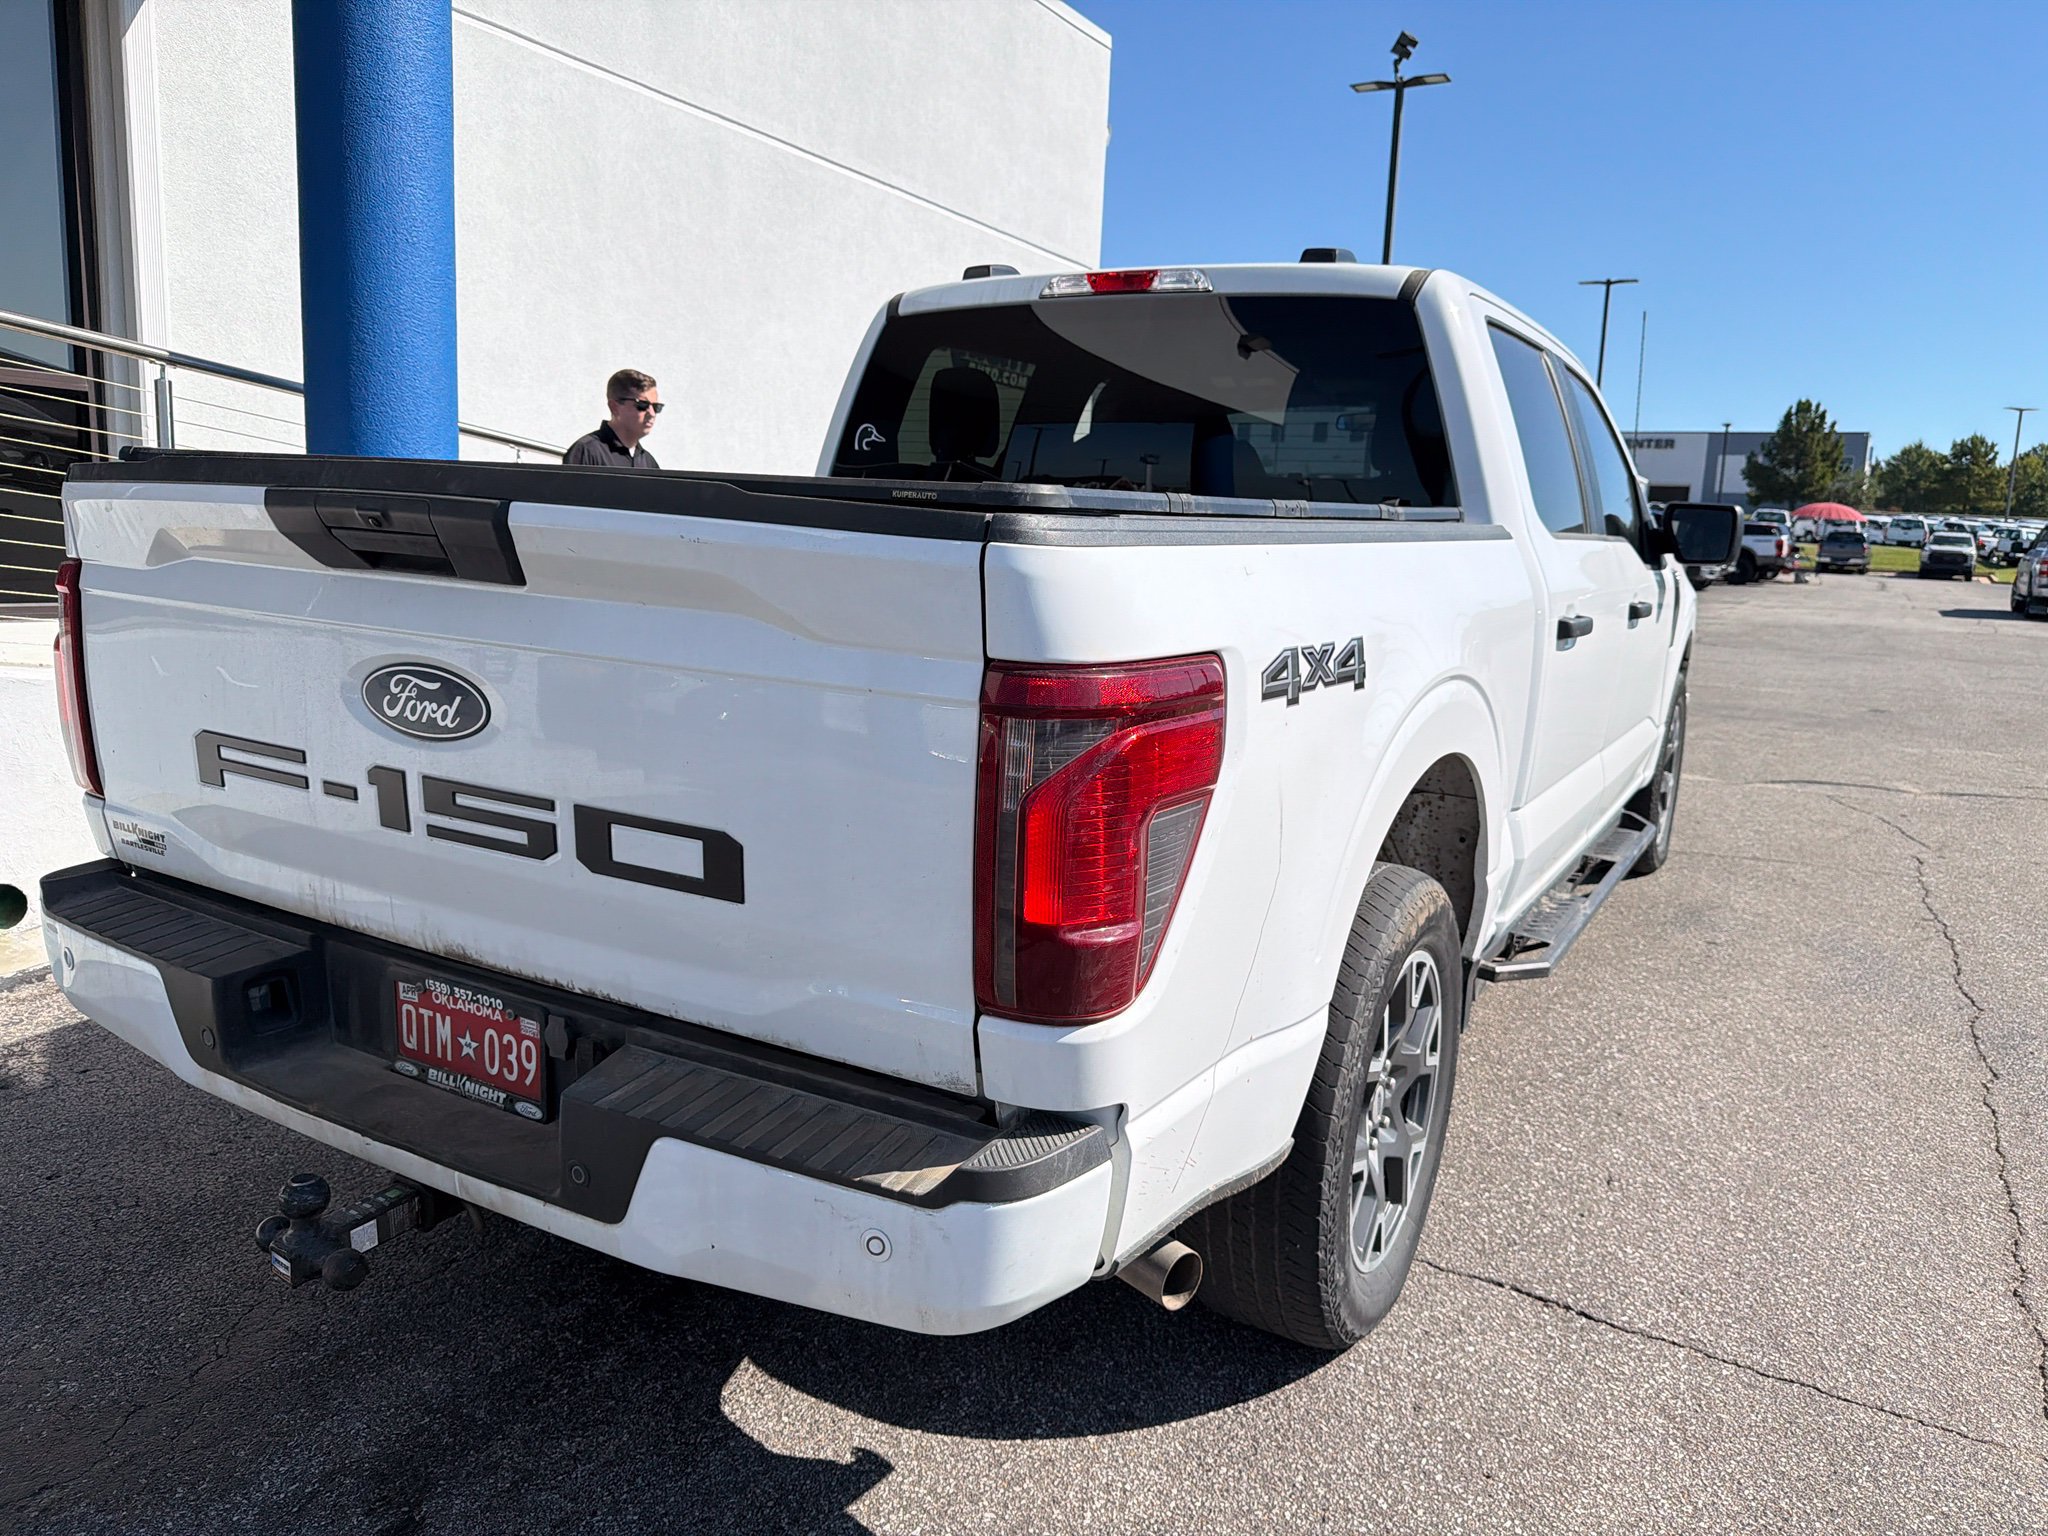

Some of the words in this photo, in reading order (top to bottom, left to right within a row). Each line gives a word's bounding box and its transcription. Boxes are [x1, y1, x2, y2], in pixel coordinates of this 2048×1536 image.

[892, 490, 937, 500] KUIPERAUTO
[382, 673, 462, 728] Ford
[194, 729, 746, 905] F-150
[120, 837, 166, 857] BARTLESVILLE
[425, 978, 451, 996] (539)
[453, 986, 504, 1011] 357-1010
[431, 991, 503, 1022] OKLAHOMA
[401, 1003, 453, 1062] QTM
[484, 1028, 538, 1087] 039
[519, 1103, 538, 1118] Ford
